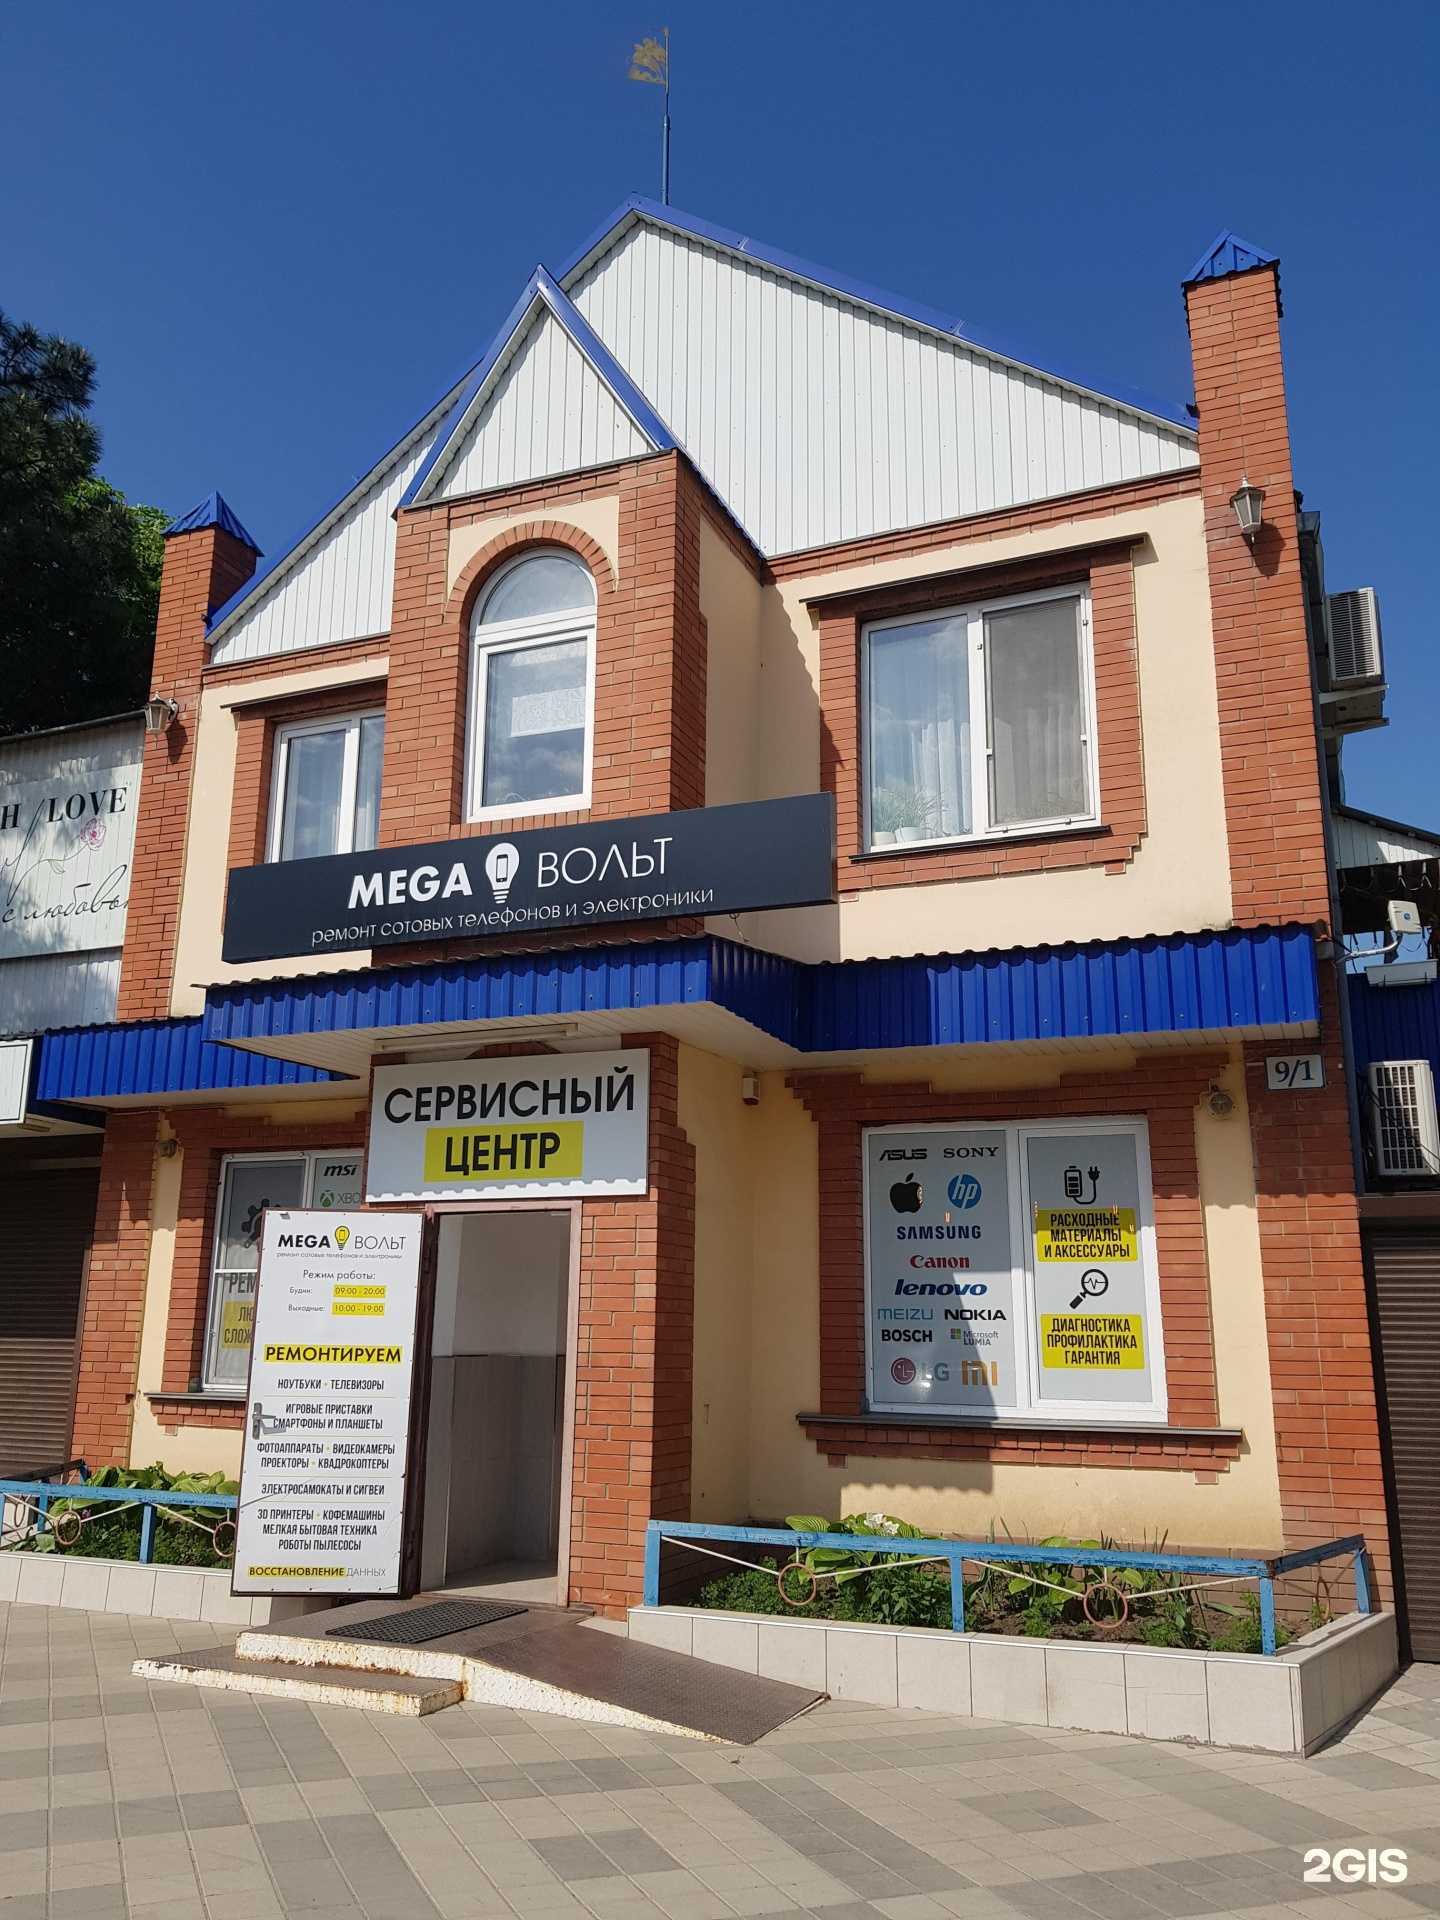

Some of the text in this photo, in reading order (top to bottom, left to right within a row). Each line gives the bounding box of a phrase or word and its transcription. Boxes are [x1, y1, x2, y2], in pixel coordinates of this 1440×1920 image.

[47, 787, 127, 823] LOVE
[348, 837, 673, 909] MEGA ВОЛЬТ
[312, 889, 714, 947] ремонт сотовых телефонов и электроники
[1275, 1059, 1315, 1087] 9/1
[384, 1066, 635, 1123] СЕРВИСНЫЙ
[445, 1132, 560, 1176] ЦЕНТР
[880, 1146, 999, 1161] ASUS SONY
[323, 1164, 358, 1176] msi
[952, 1174, 978, 1208] hp
[1051, 1212, 1120, 1227] РАСХОДНЫЕ
[896, 1225, 982, 1240] SAMSUNG
[1051, 1228, 1121, 1243] МАТЕРИАЛЫ
[277, 1234, 407, 1250] MEGA ВОЛЬТ
[1044, 1244, 1130, 1259] И АКСЕССУАРЫ
[910, 1254, 970, 1269] Canon
[303, 1270, 376, 1282] Режим работы:
[894, 1279, 988, 1296] lenovo
[335, 1305, 356, 1313] 10:00
[878, 1308, 1007, 1321] MEIZU NOKIA
[1051, 1317, 1131, 1333] ДИАГНОСТИКА
[881, 1329, 933, 1343] BOSCH
[963, 1329, 999, 1339] Microsoft
[1047, 1333, 1137, 1349] ПРОФИЛАКТИКА
[963, 1338, 992, 1346] LUMIA
[265, 1346, 401, 1362] РЕМОНТИРУЕМ
[1064, 1350, 1120, 1365] ГАРАНТИЯ
[277, 1378, 384, 1390] НОУТБУКИ ТЕЛЕВИЗОРЫ
[286, 1403, 373, 1415] ИГРОВЫЕ ПРИСТАВКИ
[273, 1418, 383, 1429] СМАРТФОНЫ И ПЛАНШЕТЫ
[257, 1443, 395, 1455] ФОТОАППАРАТЫ ВИДЕОКАМЕРЫ
[261, 1457, 389, 1469] ПРОЕКТОРЫ КВАДРОКОПТЕРЫ
[261, 1483, 385, 1495] ЭЛЕКТРОСАМОКАТЫ И СИГВЕИ
[257, 1509, 385, 1521] 3D ПРИНТЕРЫ КОФЕМАШИНЫ
[262, 1524, 377, 1535] МЕЛКАЯ БЫТОВАЯ ТЕХНИКА
[278, 1539, 361, 1550] РОБОТЫ ПЫЛЕСОСЫ
[249, 1566, 386, 1577] ВОССТАНОВЛЕНИЕ ДАННЫХ
